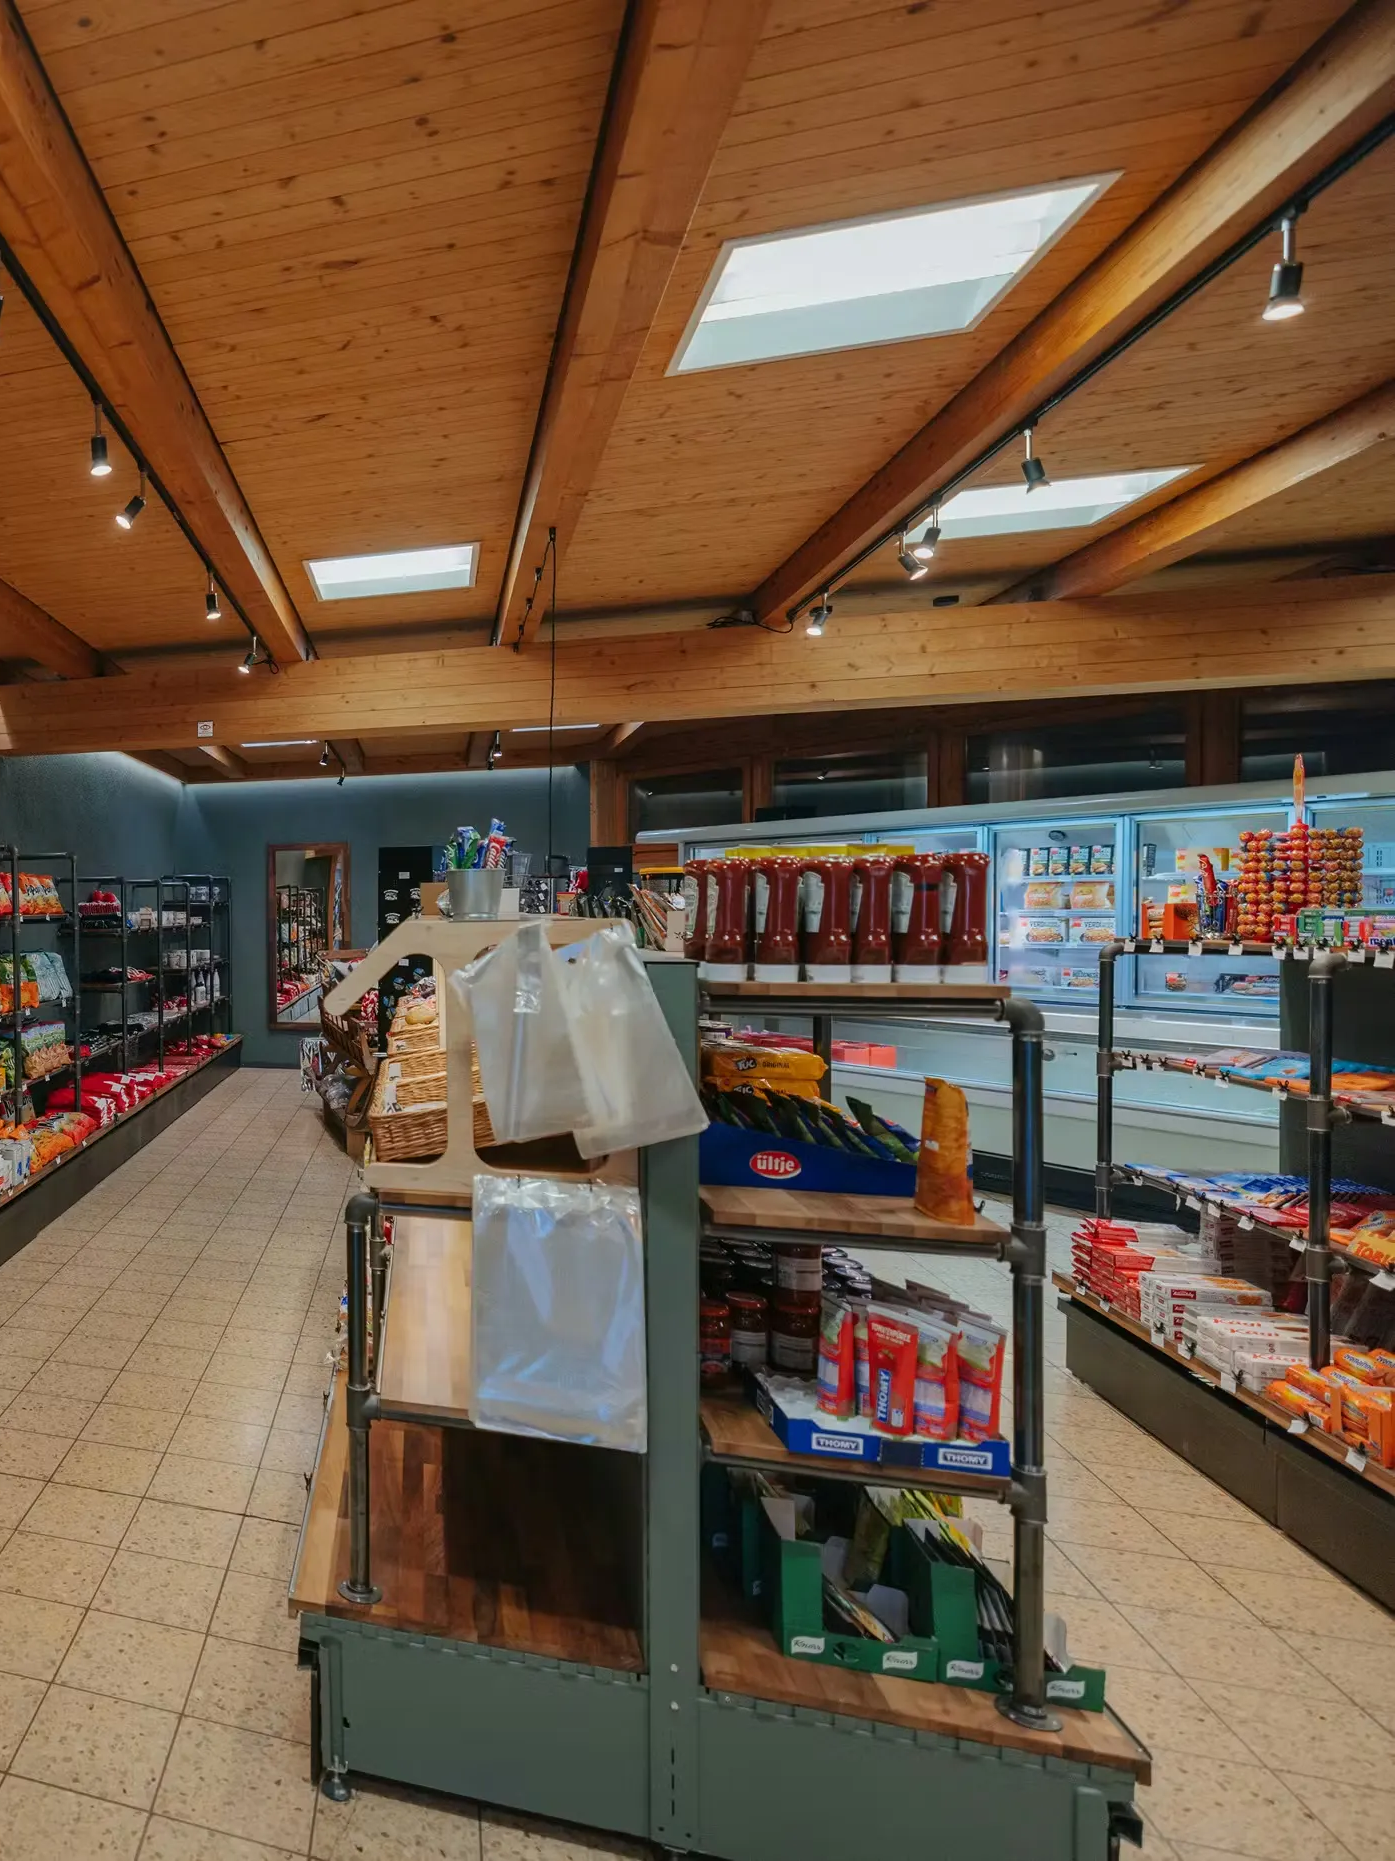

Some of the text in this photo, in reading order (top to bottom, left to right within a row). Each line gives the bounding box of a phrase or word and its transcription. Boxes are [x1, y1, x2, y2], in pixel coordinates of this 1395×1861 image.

[737, 1059, 790, 1071] TUC ORIGINAL
[756, 1154, 795, 1174] ültje
[878, 1371, 891, 1422] THOMY
[817, 1437, 858, 1450] THOMY
[944, 1452, 987, 1466] THOMY
